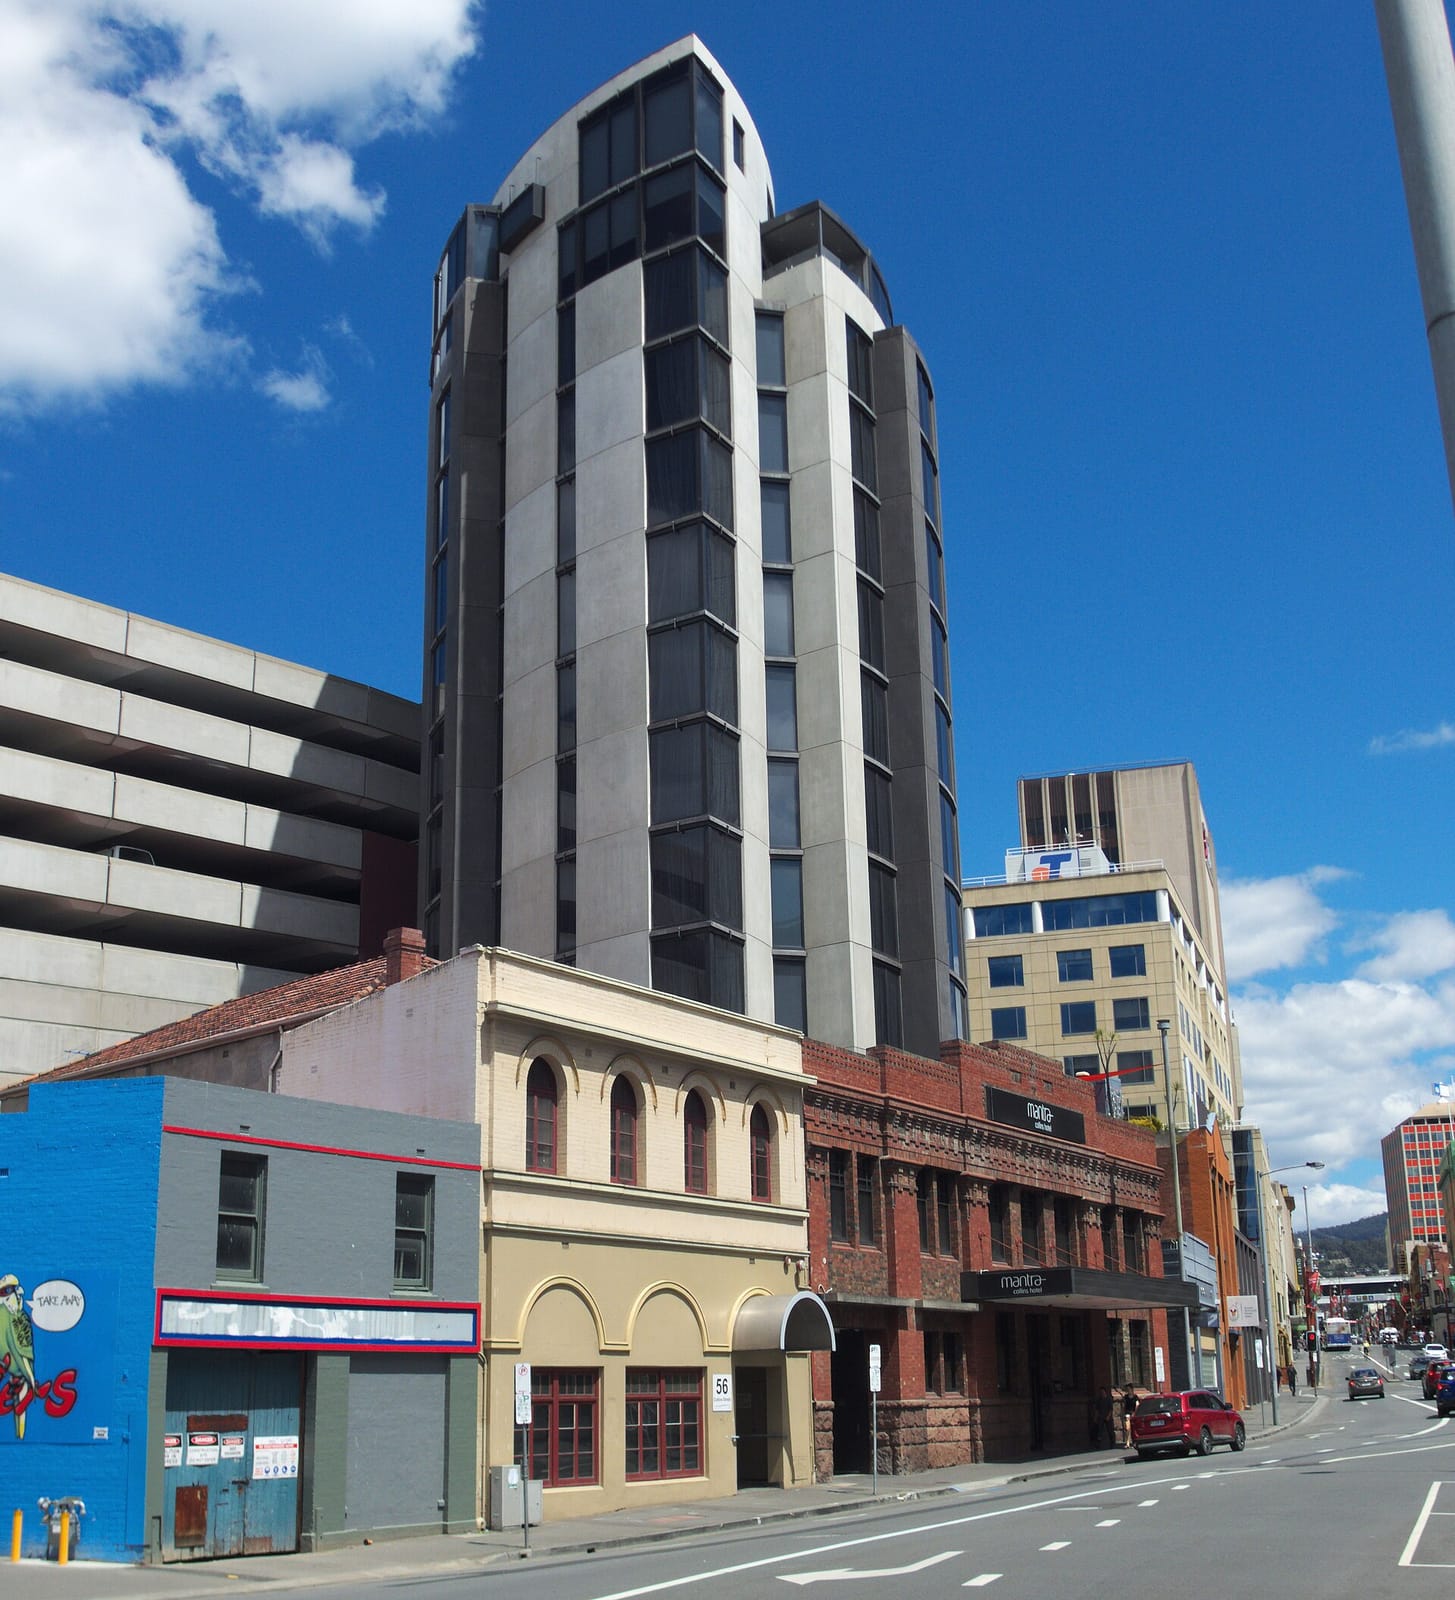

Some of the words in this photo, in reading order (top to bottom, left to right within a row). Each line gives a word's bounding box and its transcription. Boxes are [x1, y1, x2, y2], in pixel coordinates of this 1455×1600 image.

[1027, 1102, 1054, 1123] mantra
[1001, 1273, 1047, 1288] mantra
[1012, 1287, 1029, 1295] collins
[36, 1295, 59, 1307] TAKE
[60, 1294, 82, 1306] AWAY
[716, 1378, 729, 1395] 56
